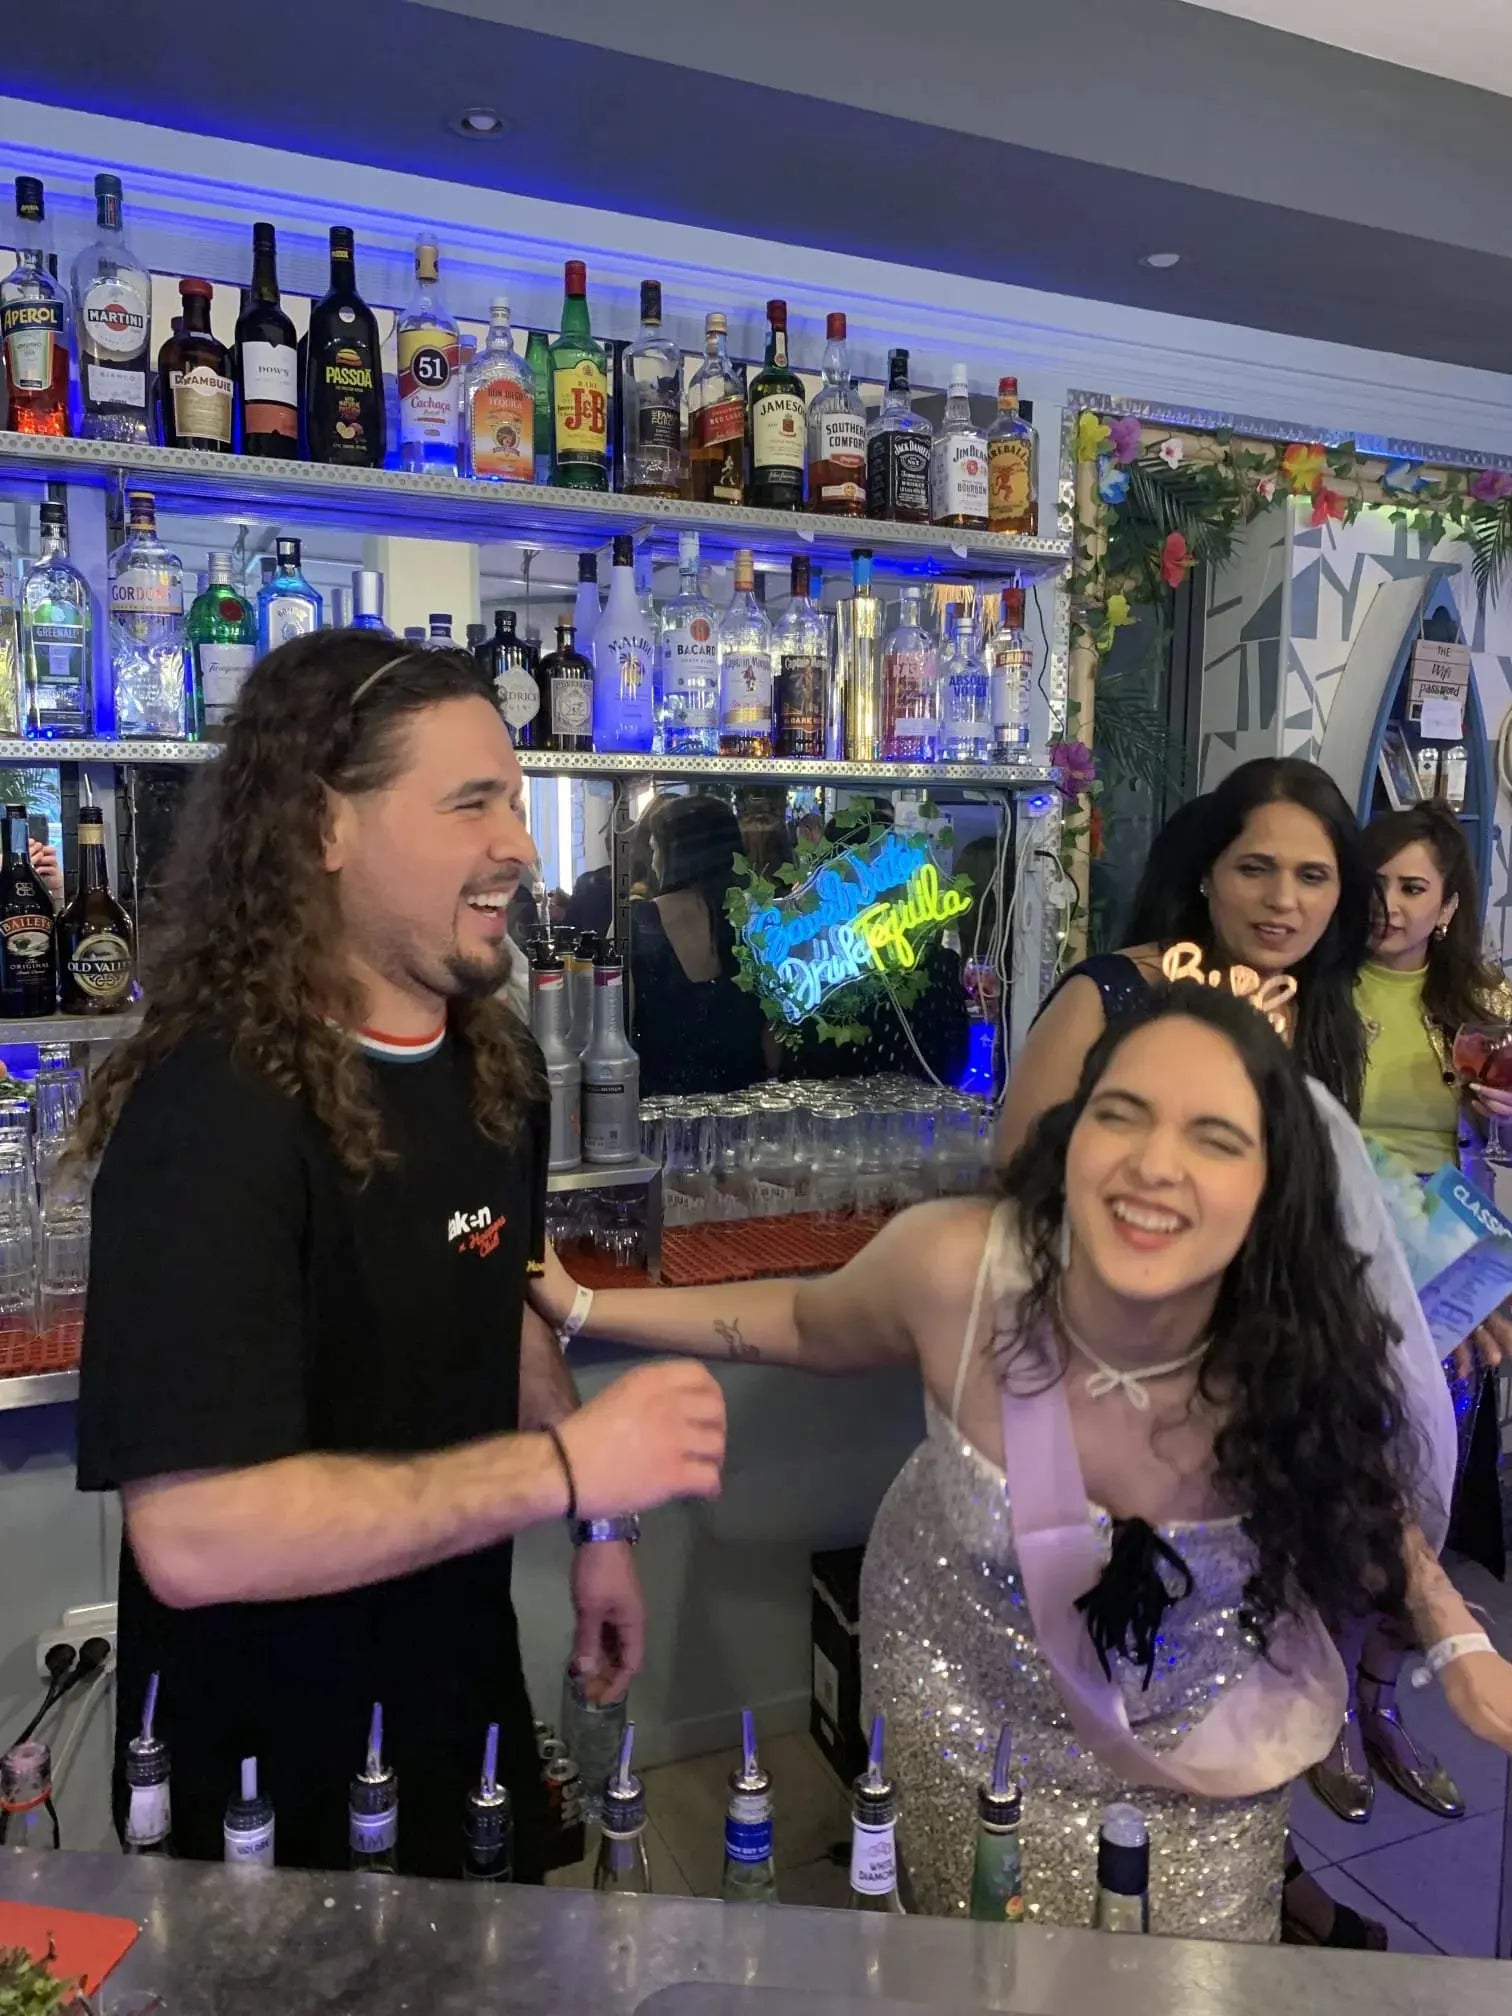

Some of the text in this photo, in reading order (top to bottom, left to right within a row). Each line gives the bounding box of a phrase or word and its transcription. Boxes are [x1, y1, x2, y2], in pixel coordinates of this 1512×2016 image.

[3, 308, 58, 331] APEROL
[88, 309, 143, 328] MARTINI
[419, 356, 444, 380] 51
[564, 387, 606, 435] J&B
[894, 442, 909, 456] JACK
[953, 447, 969, 463] JIM
[676, 644, 717, 657] BACARD
[1436, 645, 1451, 657] THE
[1417, 683, 1460, 698] password
[1, 916, 52, 932] BAILEYS
[776, 863, 972, 1011] Drink Tequila
[67, 961, 131, 973] OLD VALL
